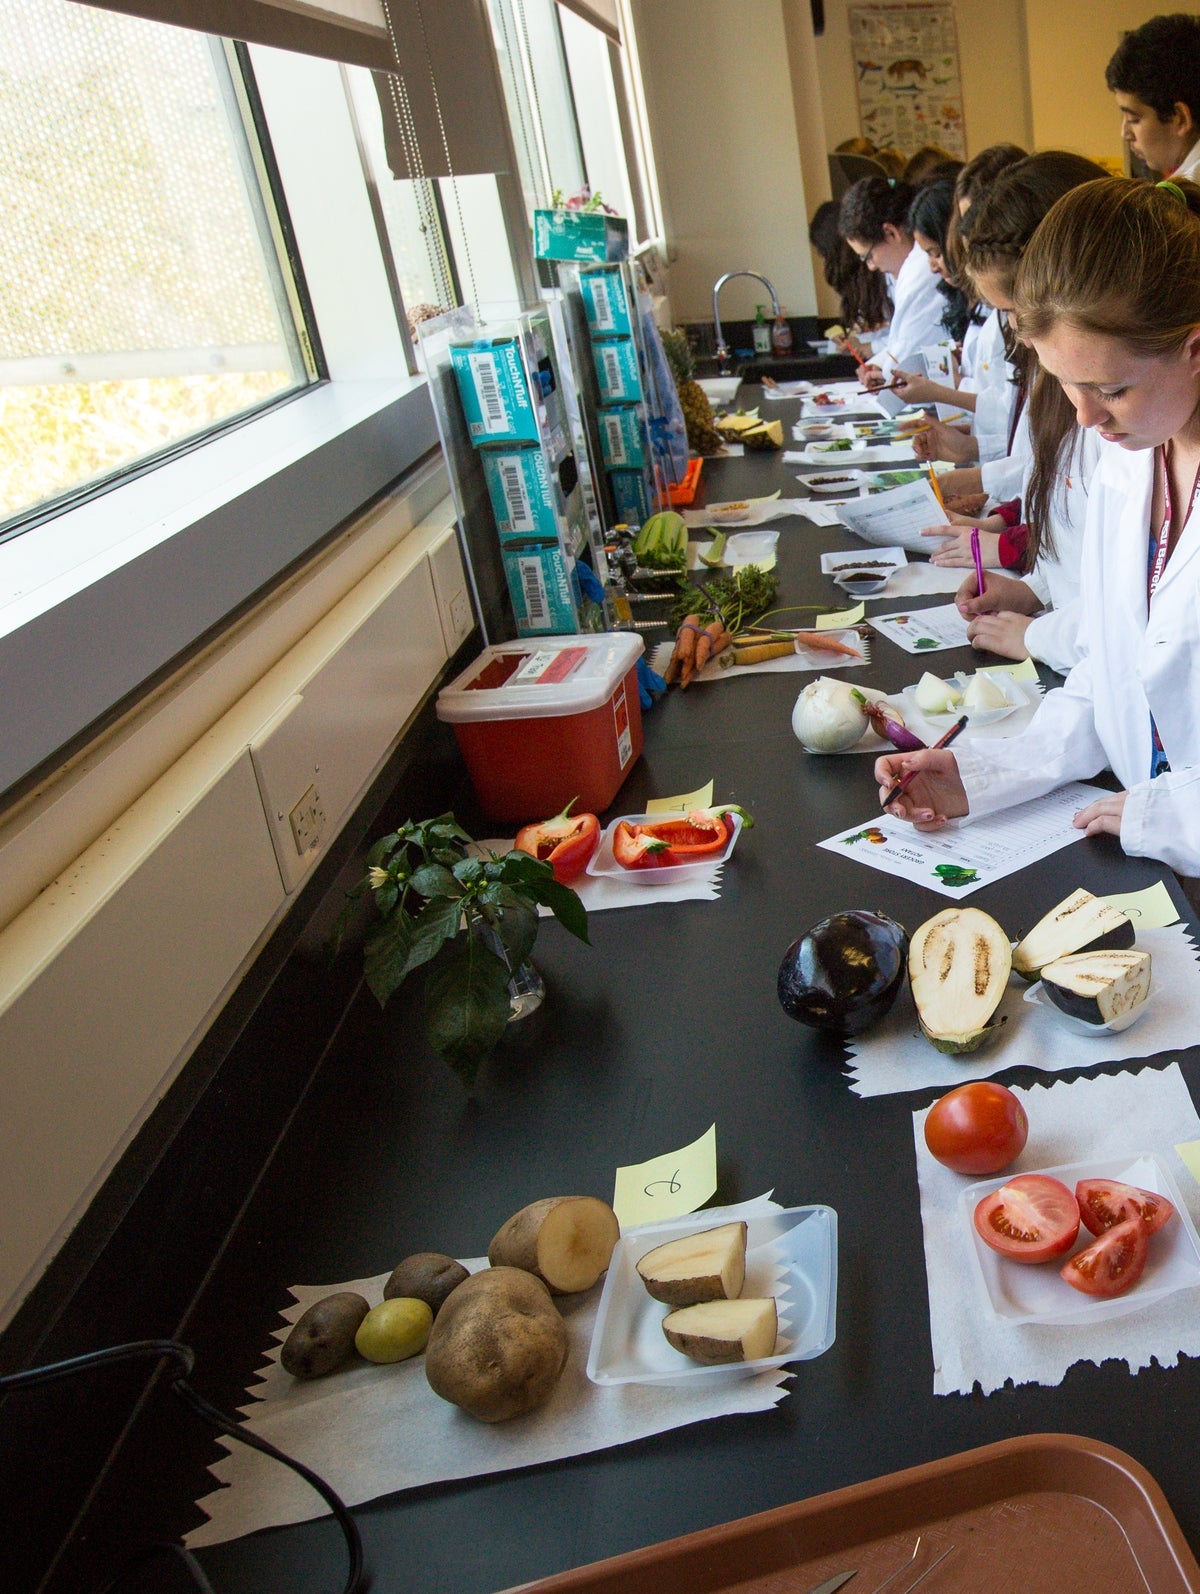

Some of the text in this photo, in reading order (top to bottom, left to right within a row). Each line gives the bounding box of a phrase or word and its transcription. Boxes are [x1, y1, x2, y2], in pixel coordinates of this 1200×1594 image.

[505, 345, 528, 408] TouchNTuff
[553, 548, 570, 606] TouchNTuff
[644, 1169, 682, 1197] 2
